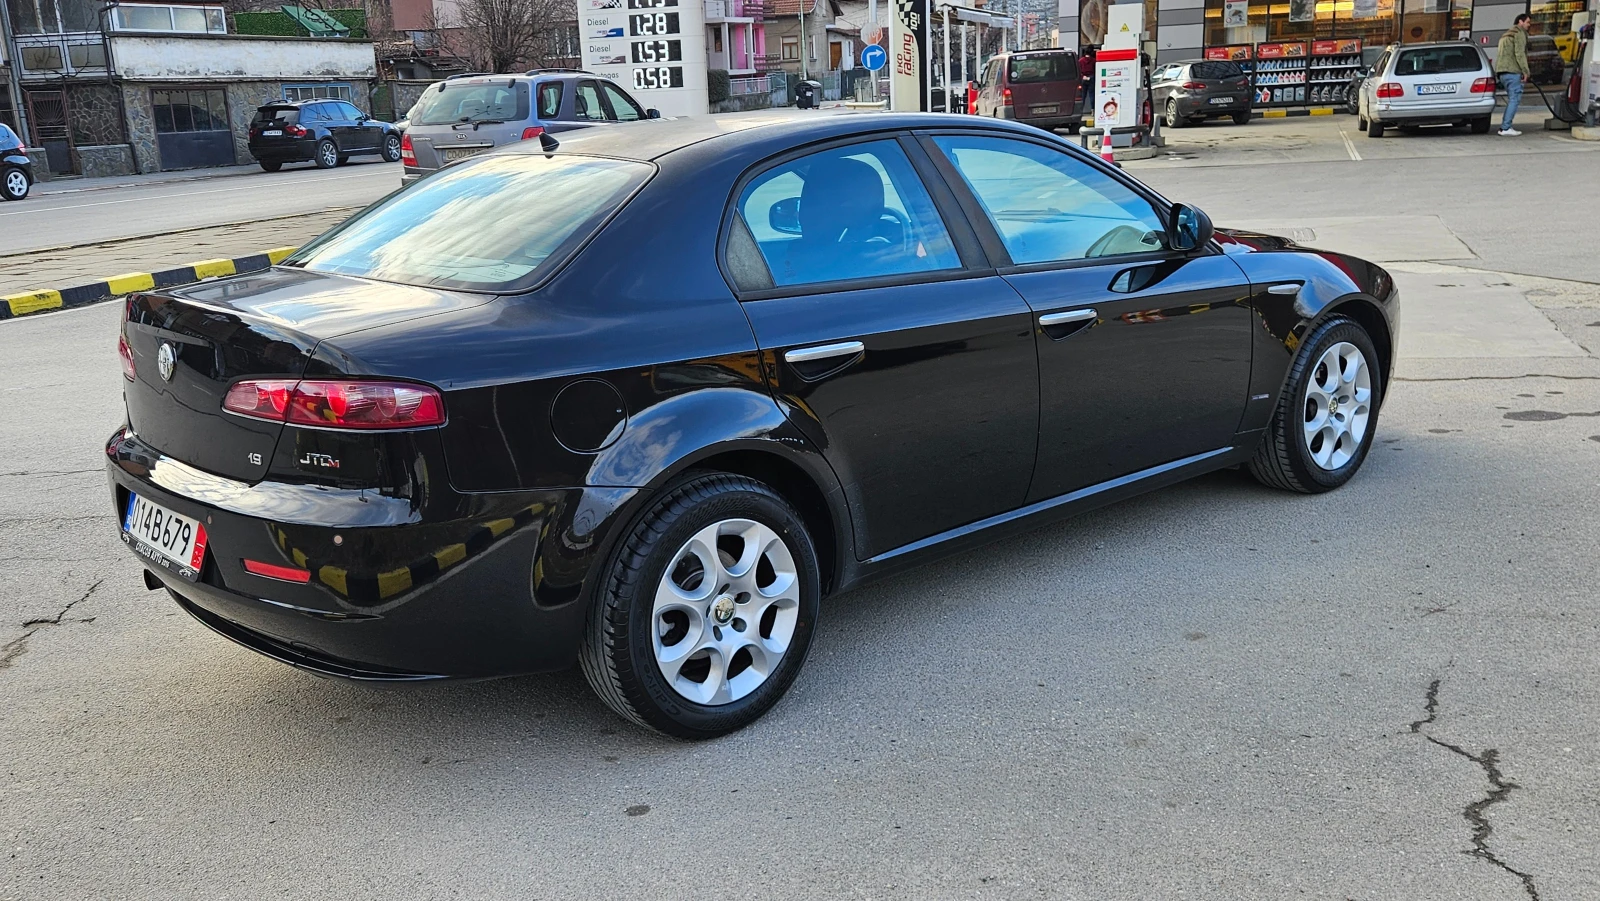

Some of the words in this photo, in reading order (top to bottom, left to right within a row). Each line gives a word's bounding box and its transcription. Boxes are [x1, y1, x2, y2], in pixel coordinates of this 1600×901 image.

[587, 18, 609, 26] Diesel
[636, 13, 667, 35] 1.28
[910, 11, 918, 30] 100
[589, 45, 611, 53] Diesel
[638, 40, 669, 62] 1.53
[903, 33, 914, 76] racing
[896, 53, 904, 74] EKO
[633, 67, 671, 89] 0.58
